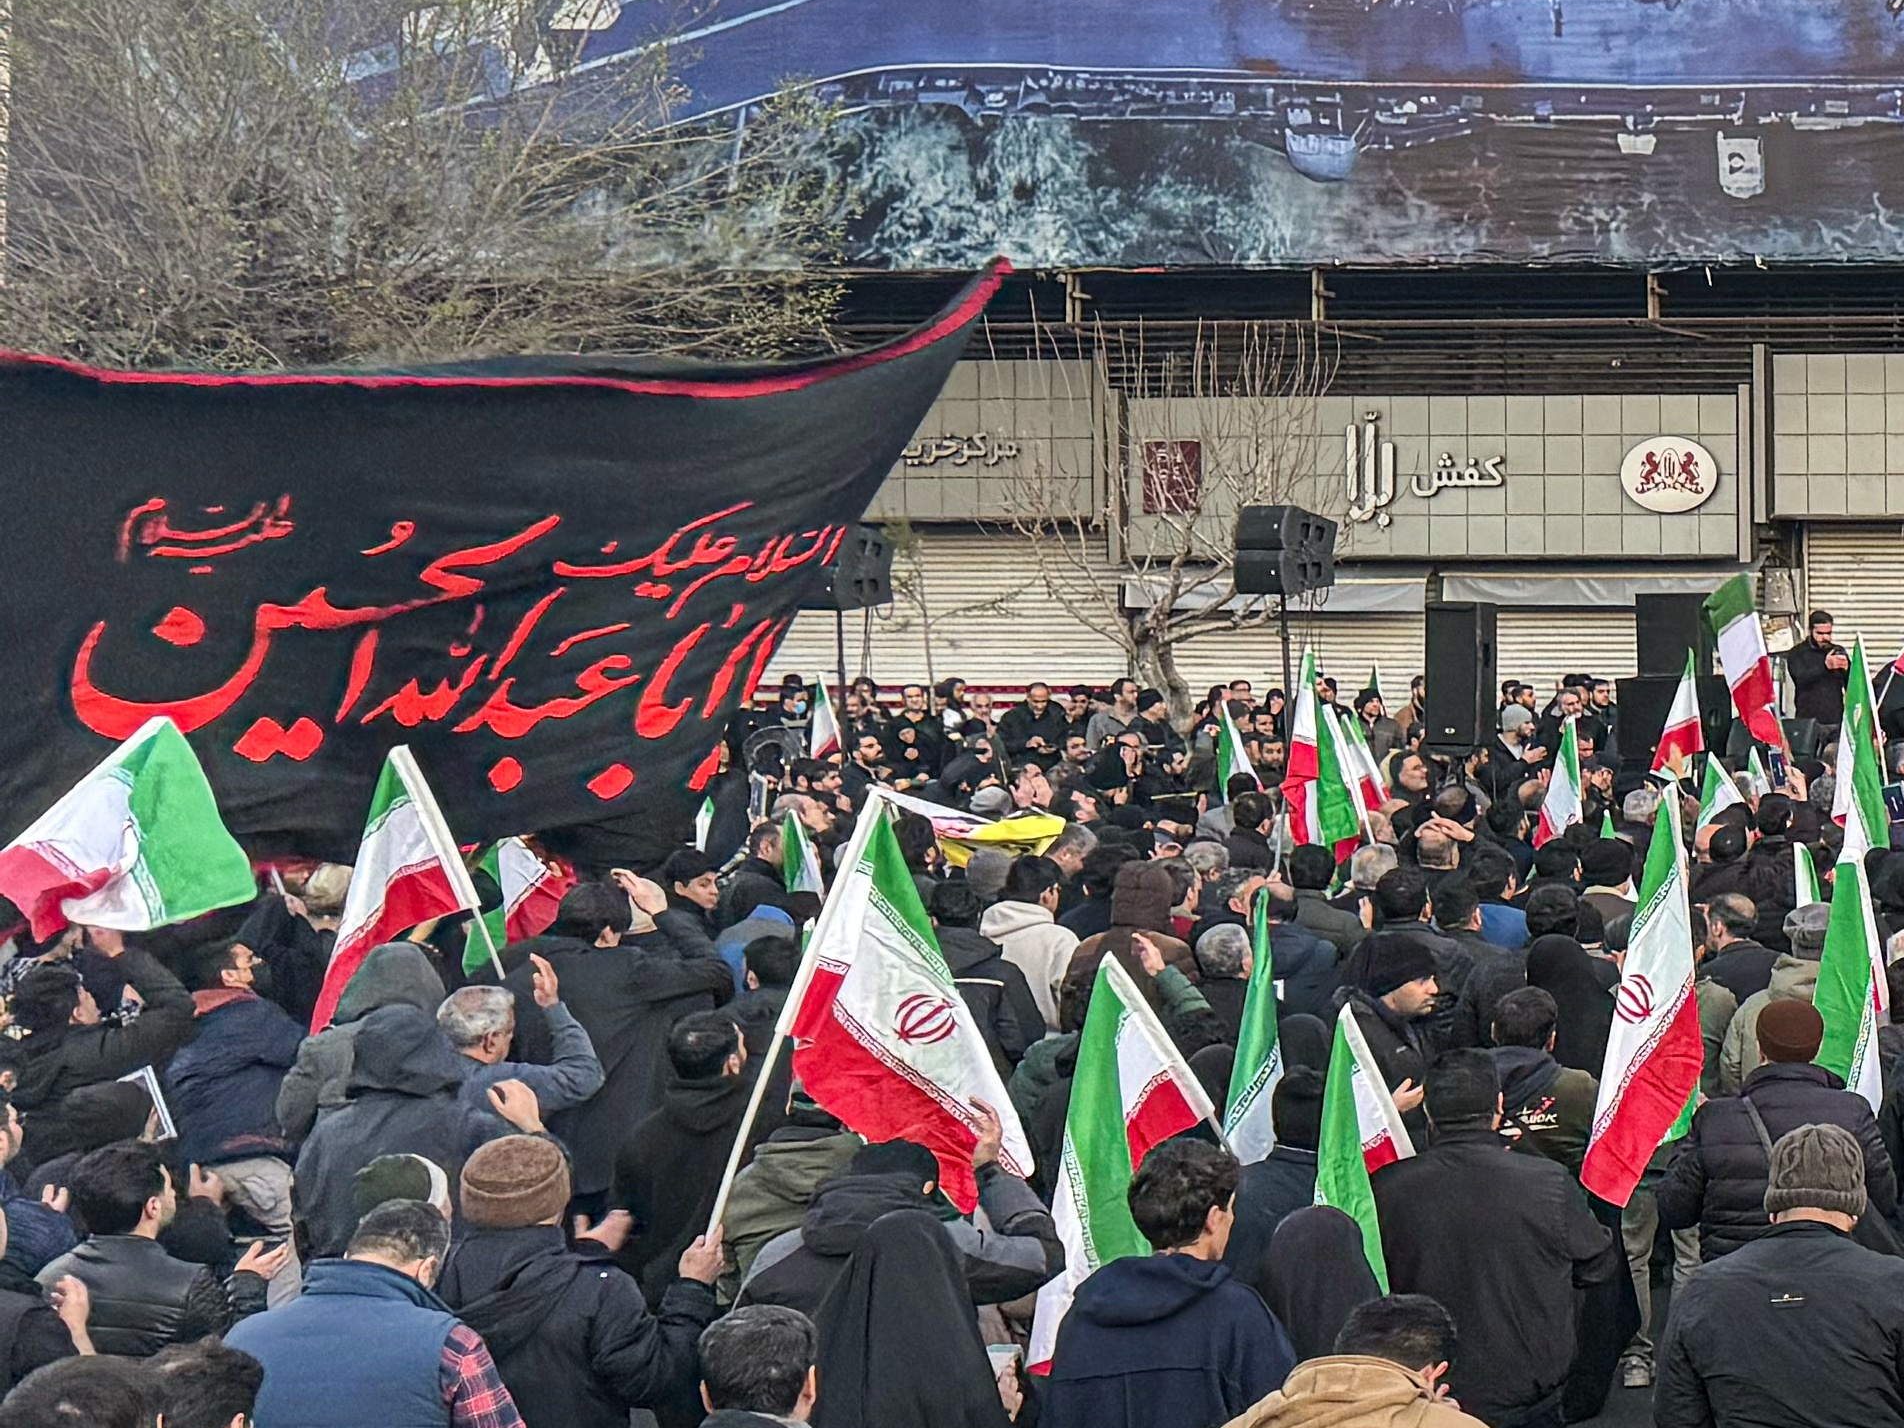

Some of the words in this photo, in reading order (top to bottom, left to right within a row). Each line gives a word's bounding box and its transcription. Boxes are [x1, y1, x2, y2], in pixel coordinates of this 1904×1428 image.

[902, 432, 960, 466] خری
[958, 432, 1021, 467] مرکز
[1411, 452, 1506, 497] کفش
